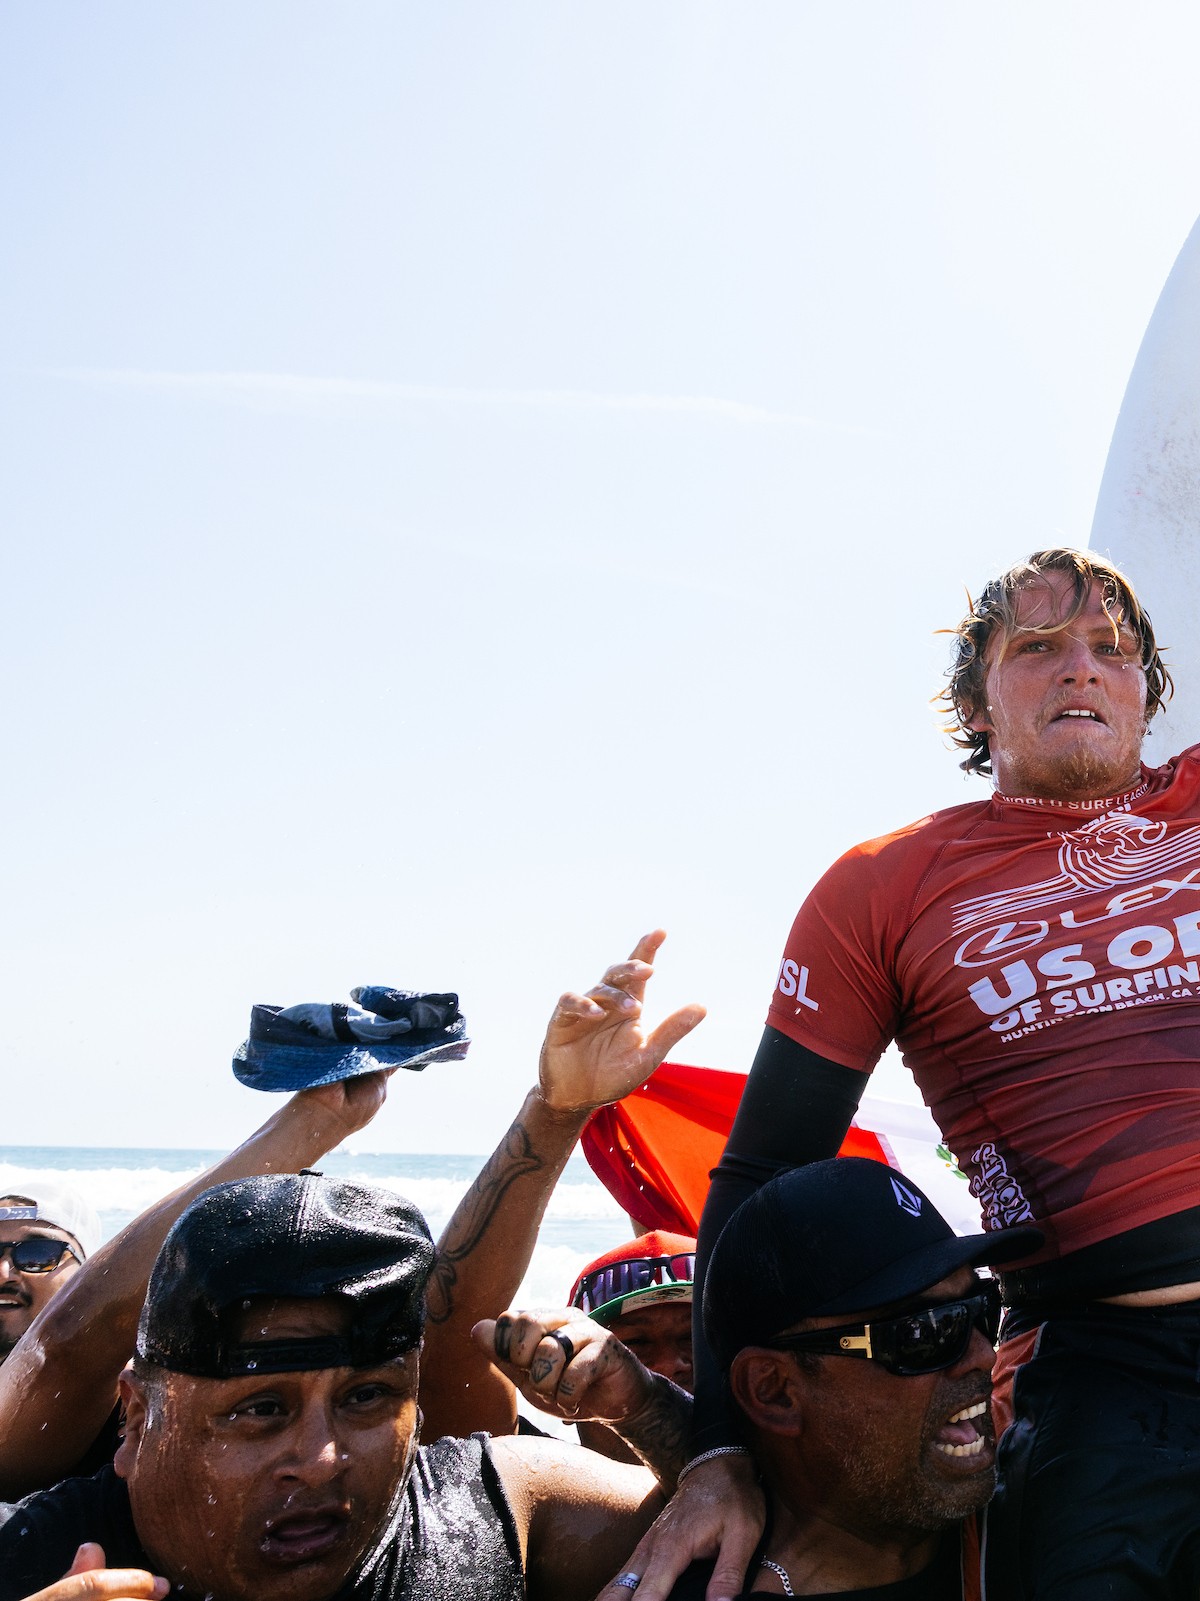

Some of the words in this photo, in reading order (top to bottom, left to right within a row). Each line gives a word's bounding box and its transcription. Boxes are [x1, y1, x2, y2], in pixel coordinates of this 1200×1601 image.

[1068, 798, 1114, 811] SURF
[775, 957, 819, 1011] SL
[967, 943, 1097, 1016] US
[1171, 987, 1193, 999] CA
[989, 999, 1043, 1032] OF
